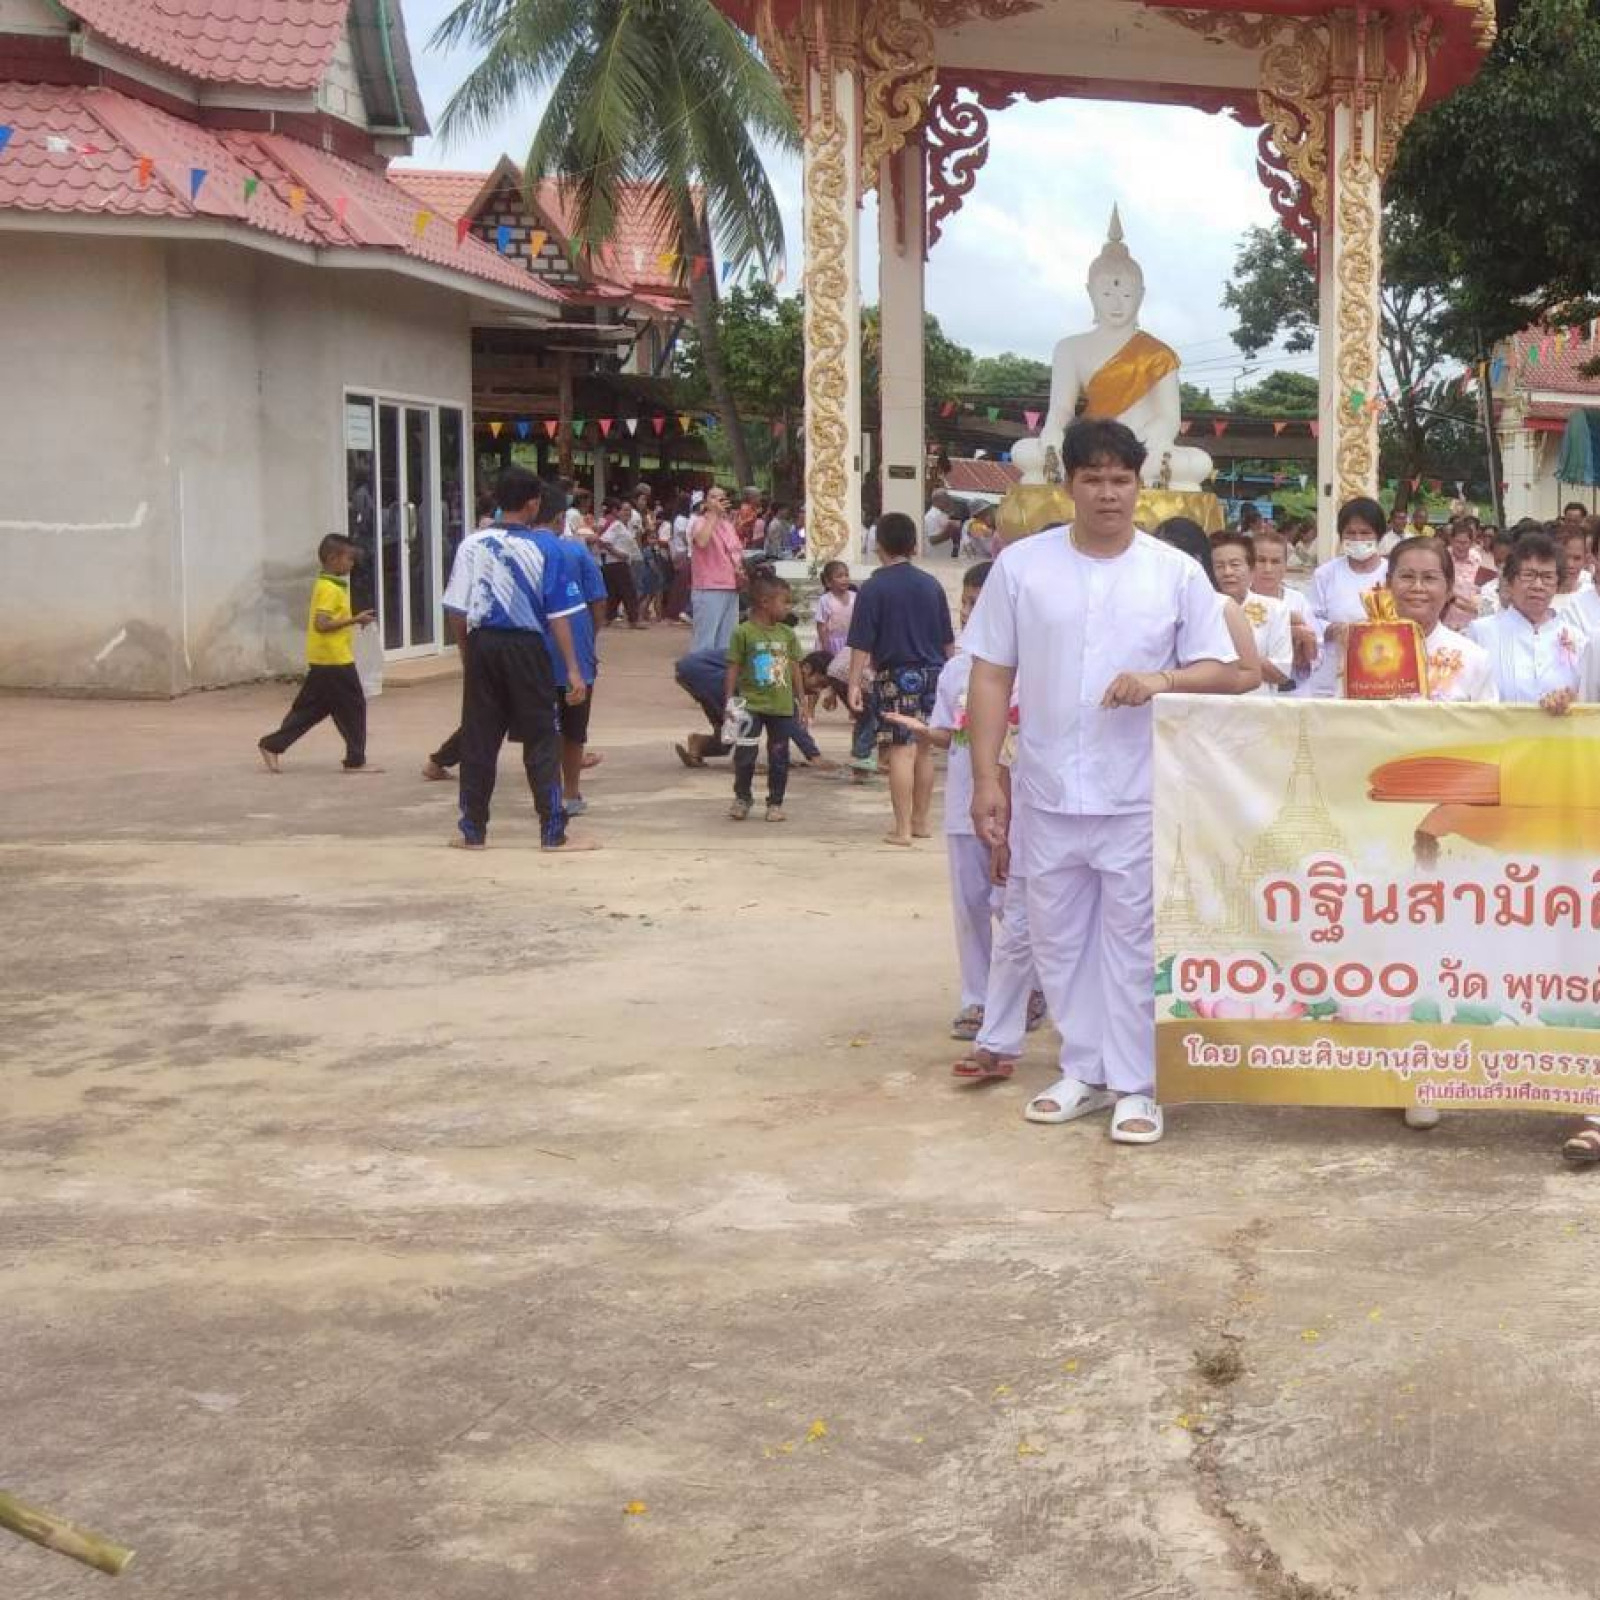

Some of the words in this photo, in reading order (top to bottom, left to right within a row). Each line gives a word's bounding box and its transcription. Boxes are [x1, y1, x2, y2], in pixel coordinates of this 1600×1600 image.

[1180, 957, 1419, 1003] ๓๐,๐๐๐
[1438, 957, 1489, 1001] วัด
[1186, 1037, 1239, 1065] โดย
[1250, 1040, 1471, 1078] คณะศิษยานุศิษย์
